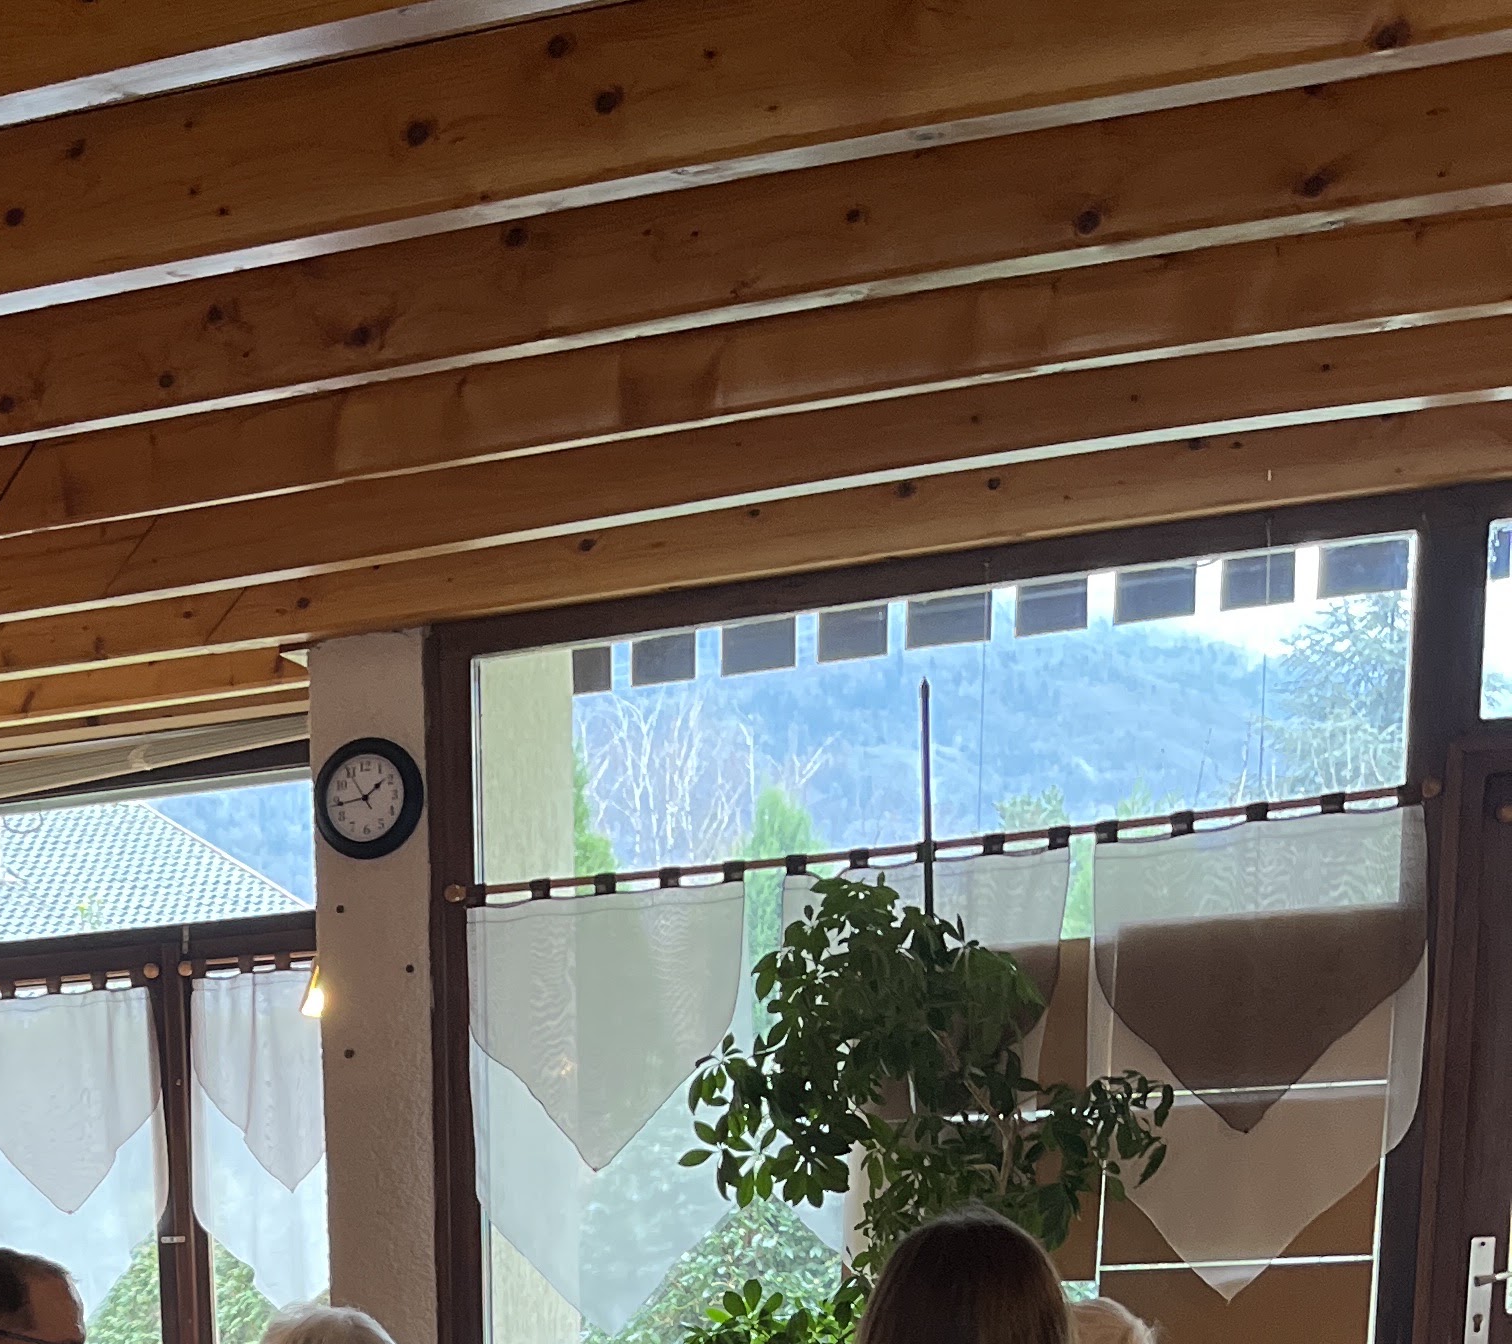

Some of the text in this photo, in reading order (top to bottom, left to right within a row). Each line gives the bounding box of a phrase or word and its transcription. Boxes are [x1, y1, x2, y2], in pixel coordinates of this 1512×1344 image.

[345, 766, 356, 778] 11
[360, 760, 371, 772] 12
[378, 762, 383, 774] 1
[388, 773, 394, 785] 2
[337, 780, 347, 791] 10
[338, 811, 345, 821] 8
[363, 824, 370, 834] 6
